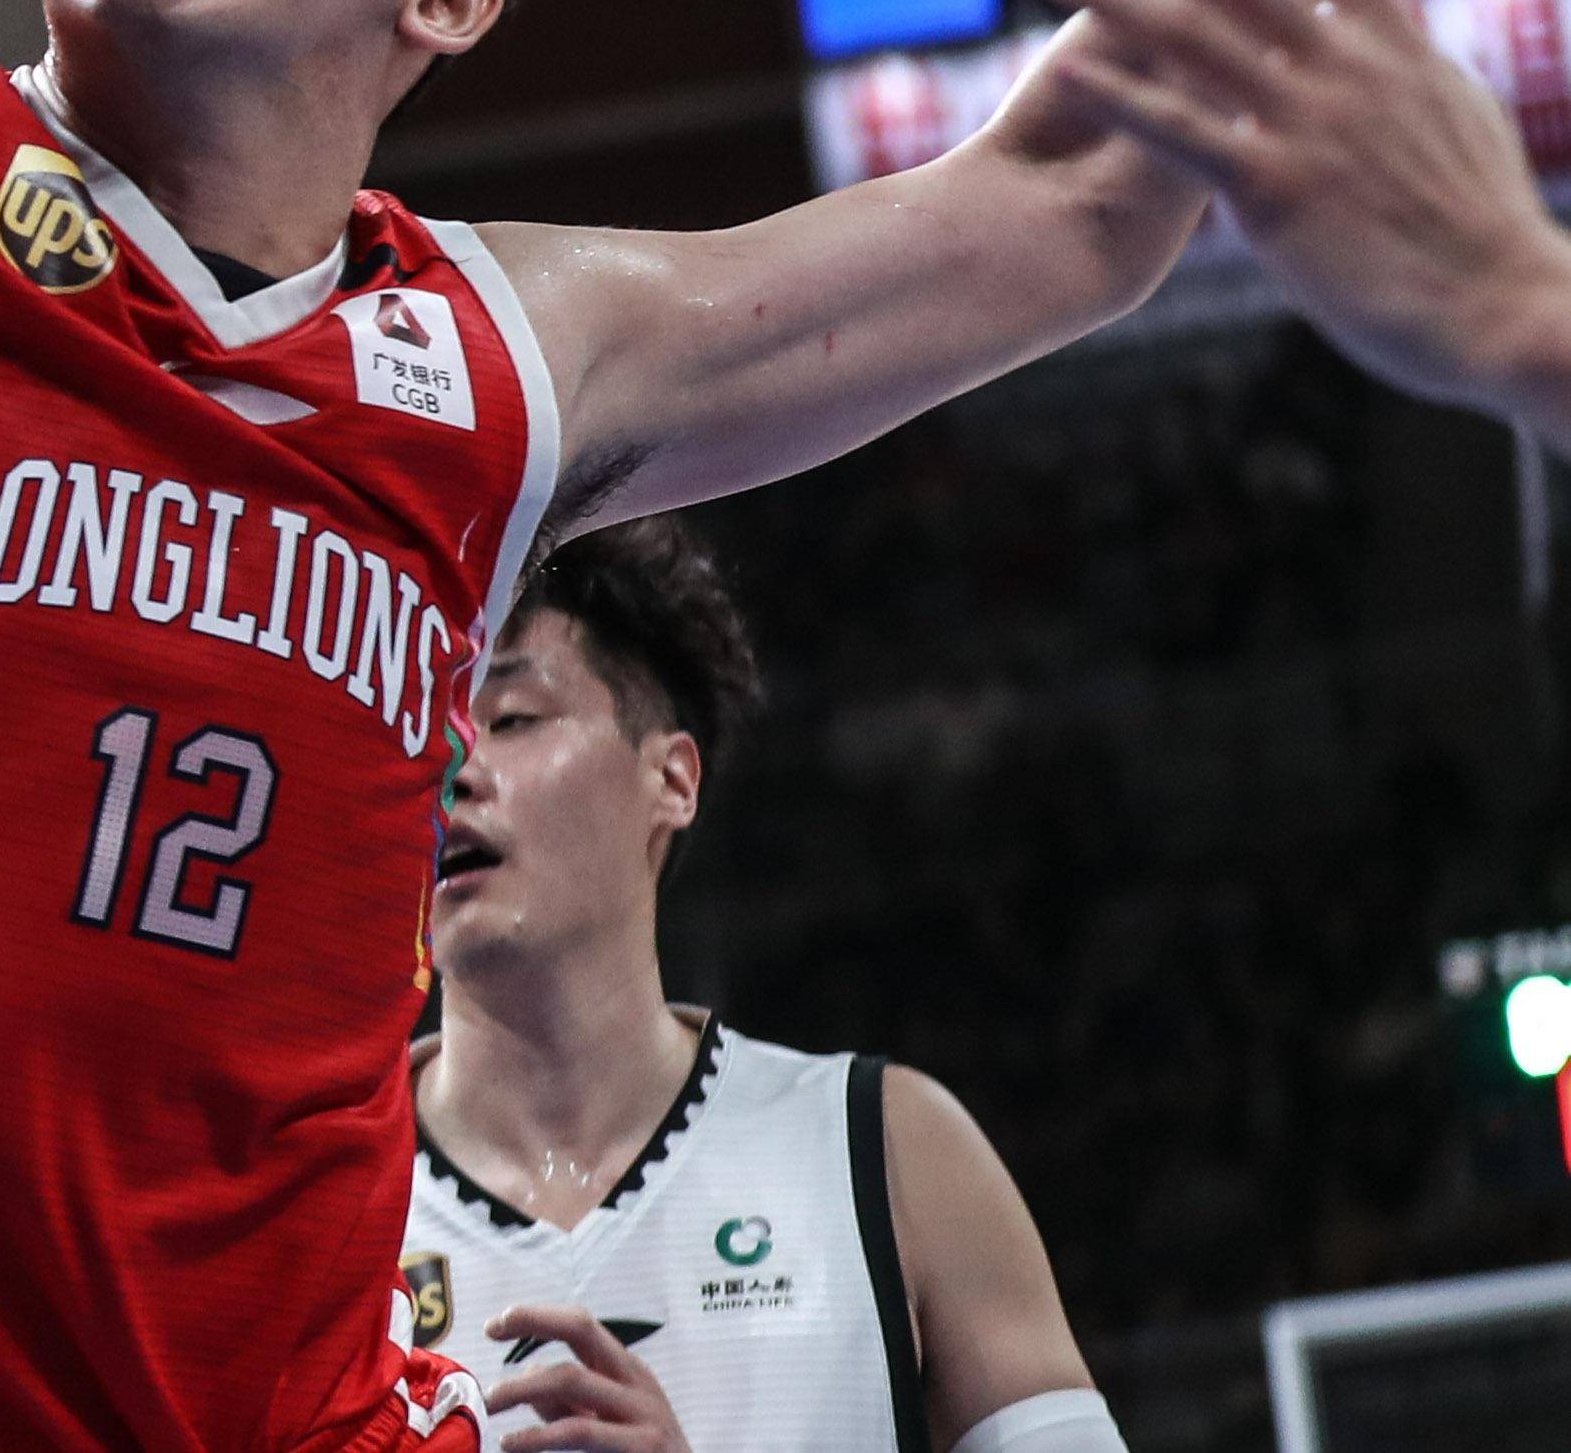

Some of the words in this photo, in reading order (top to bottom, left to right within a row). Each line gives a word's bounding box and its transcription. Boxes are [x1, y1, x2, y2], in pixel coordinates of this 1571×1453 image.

[372, 352, 452, 392] 广发银行
[391, 383, 441, 414] CGB
[70, 706, 277, 959] 12
